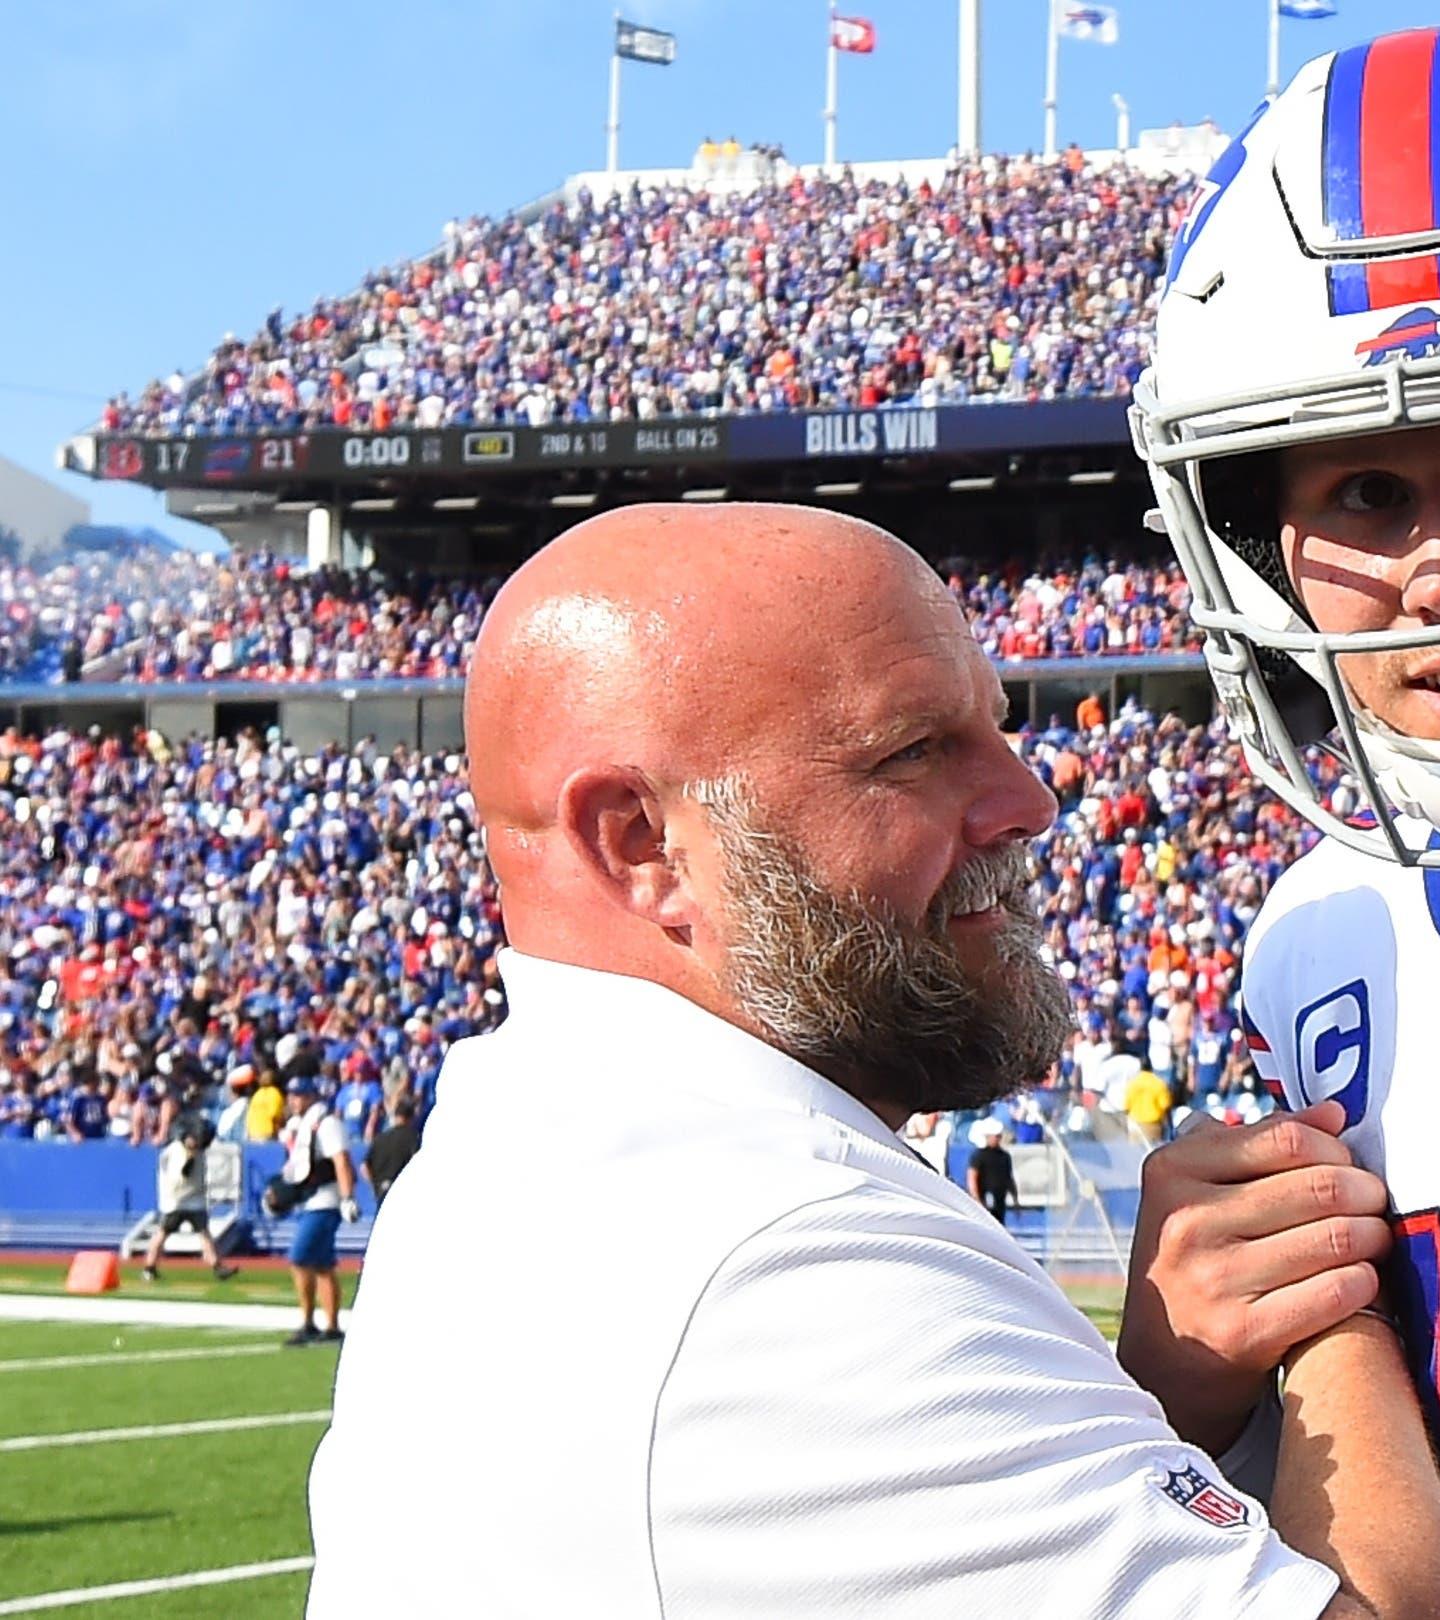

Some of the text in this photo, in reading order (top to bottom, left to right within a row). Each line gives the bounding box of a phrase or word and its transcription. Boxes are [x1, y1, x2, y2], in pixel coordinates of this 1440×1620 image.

[635, 425, 718, 451] BALL ON 25
[806, 409, 937, 454] BILLS WIN
[157, 442, 189, 473] 17
[262, 438, 295, 469] 21
[343, 435, 410, 467] 0:00
[1300, 992, 1362, 1104] C
